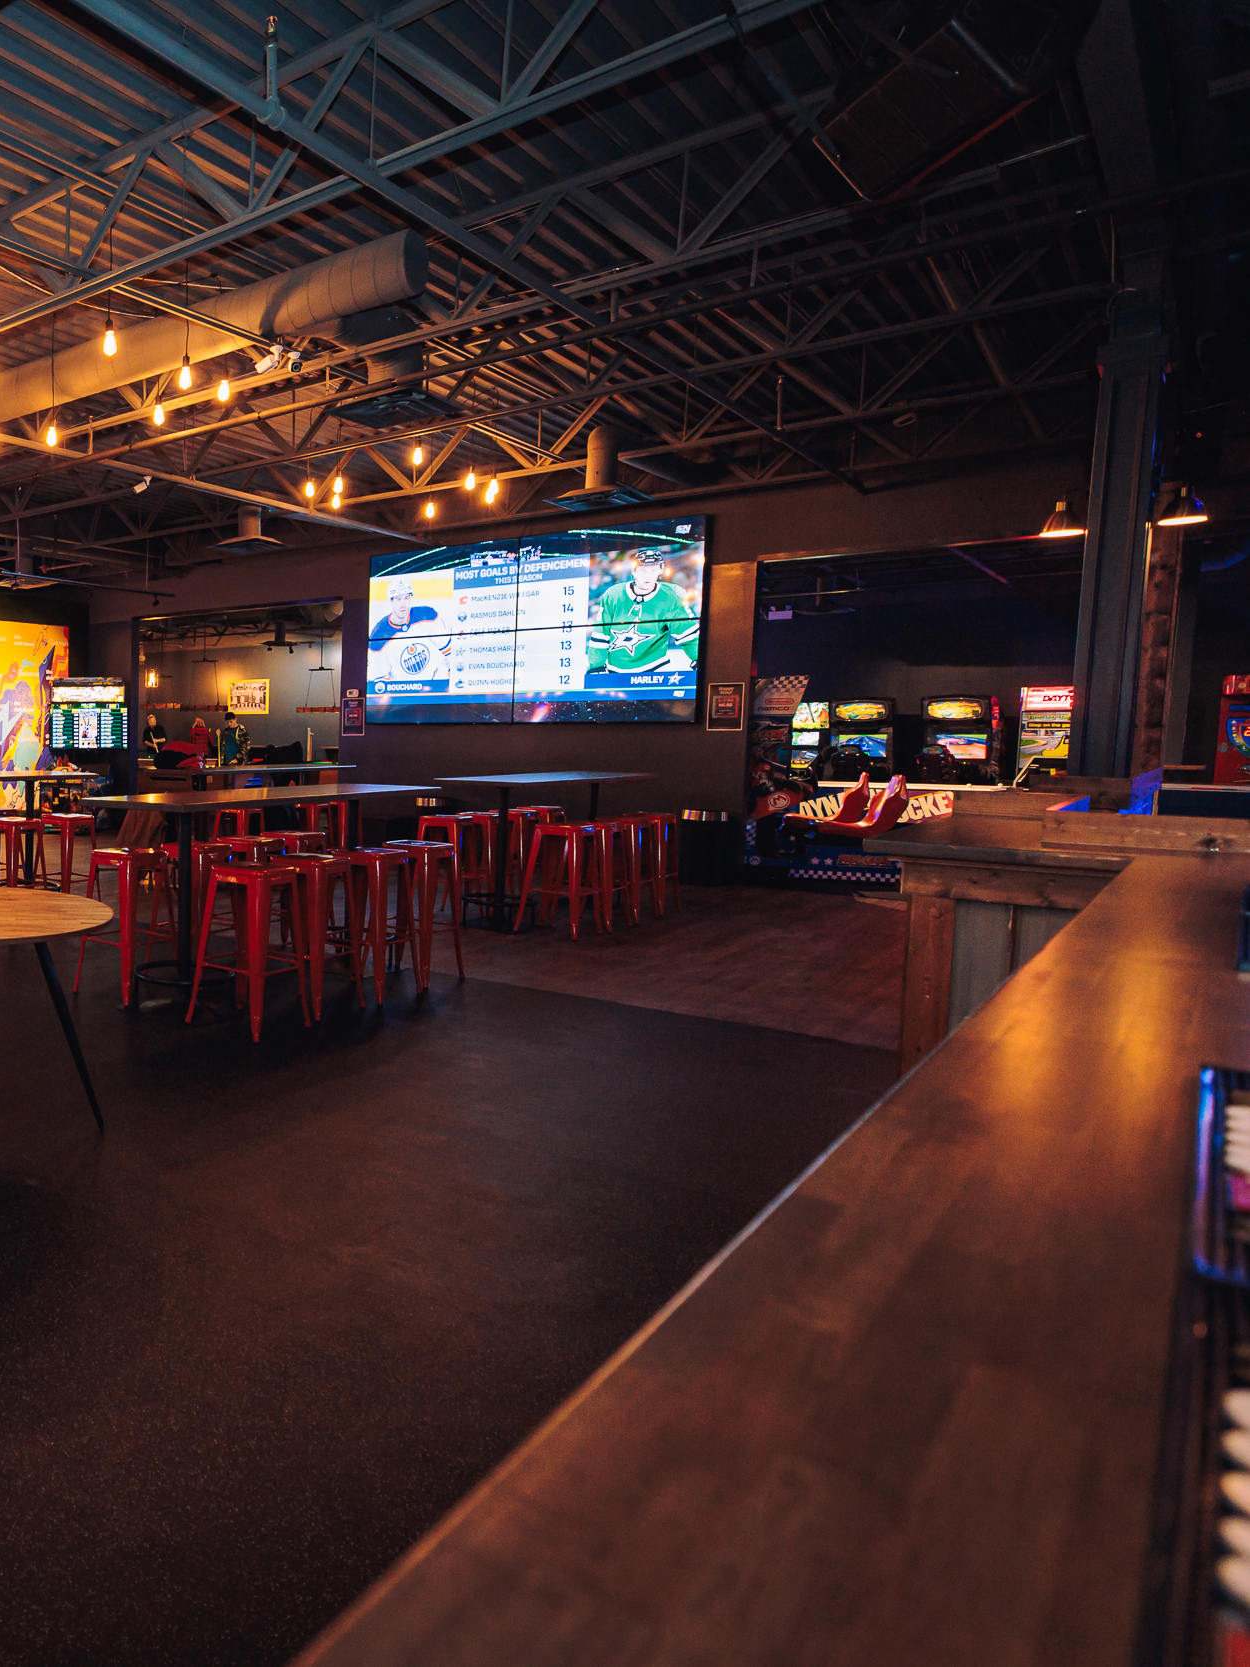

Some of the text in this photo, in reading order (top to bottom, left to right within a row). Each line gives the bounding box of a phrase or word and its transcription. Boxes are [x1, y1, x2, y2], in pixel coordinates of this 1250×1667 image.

[456, 558, 588, 580] MOST GOALS BY DEFENCEMEN
[512, 573, 543, 583] SEASON
[471, 592, 507, 602] MacKENZIE
[562, 586, 575, 596] 15
[470, 611, 497, 619] RASMUS
[562, 603, 574, 613] 14
[469, 640, 572, 653] THOMAS HARLEY 13
[468, 657, 571, 670] EVAN BOUCHARD 13
[468, 679, 489, 687] QUINN
[558, 675, 570, 685] 12
[630, 675, 665, 684] HARLEY
[386, 683, 423, 692] BOUCHARD
